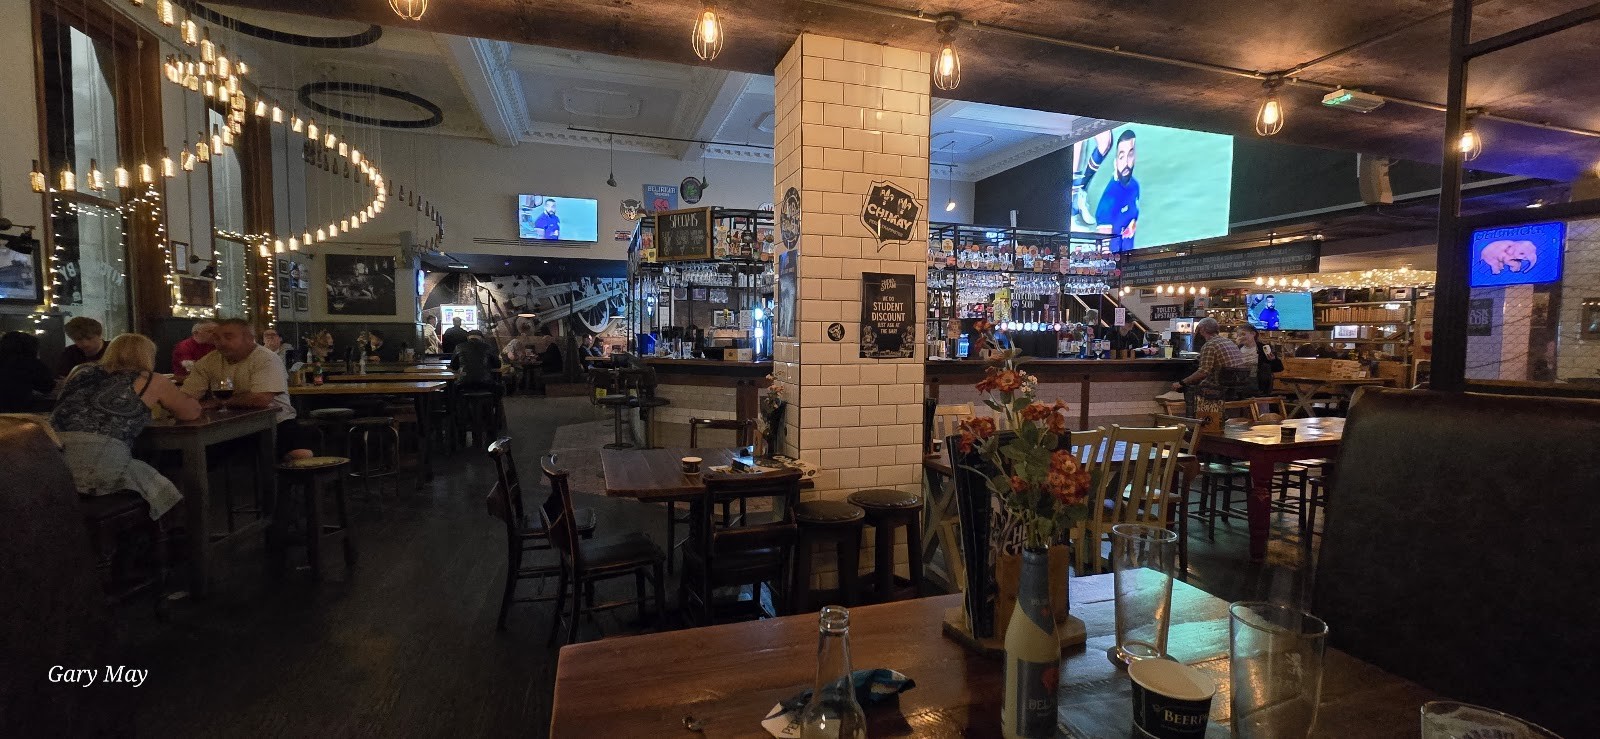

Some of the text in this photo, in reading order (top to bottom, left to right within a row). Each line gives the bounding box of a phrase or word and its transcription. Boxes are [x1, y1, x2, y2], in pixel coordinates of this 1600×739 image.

[867, 203, 912, 230] CHIMAY
[873, 302, 904, 312] STUDENT
[871, 312, 906, 322] DISCOUNT
